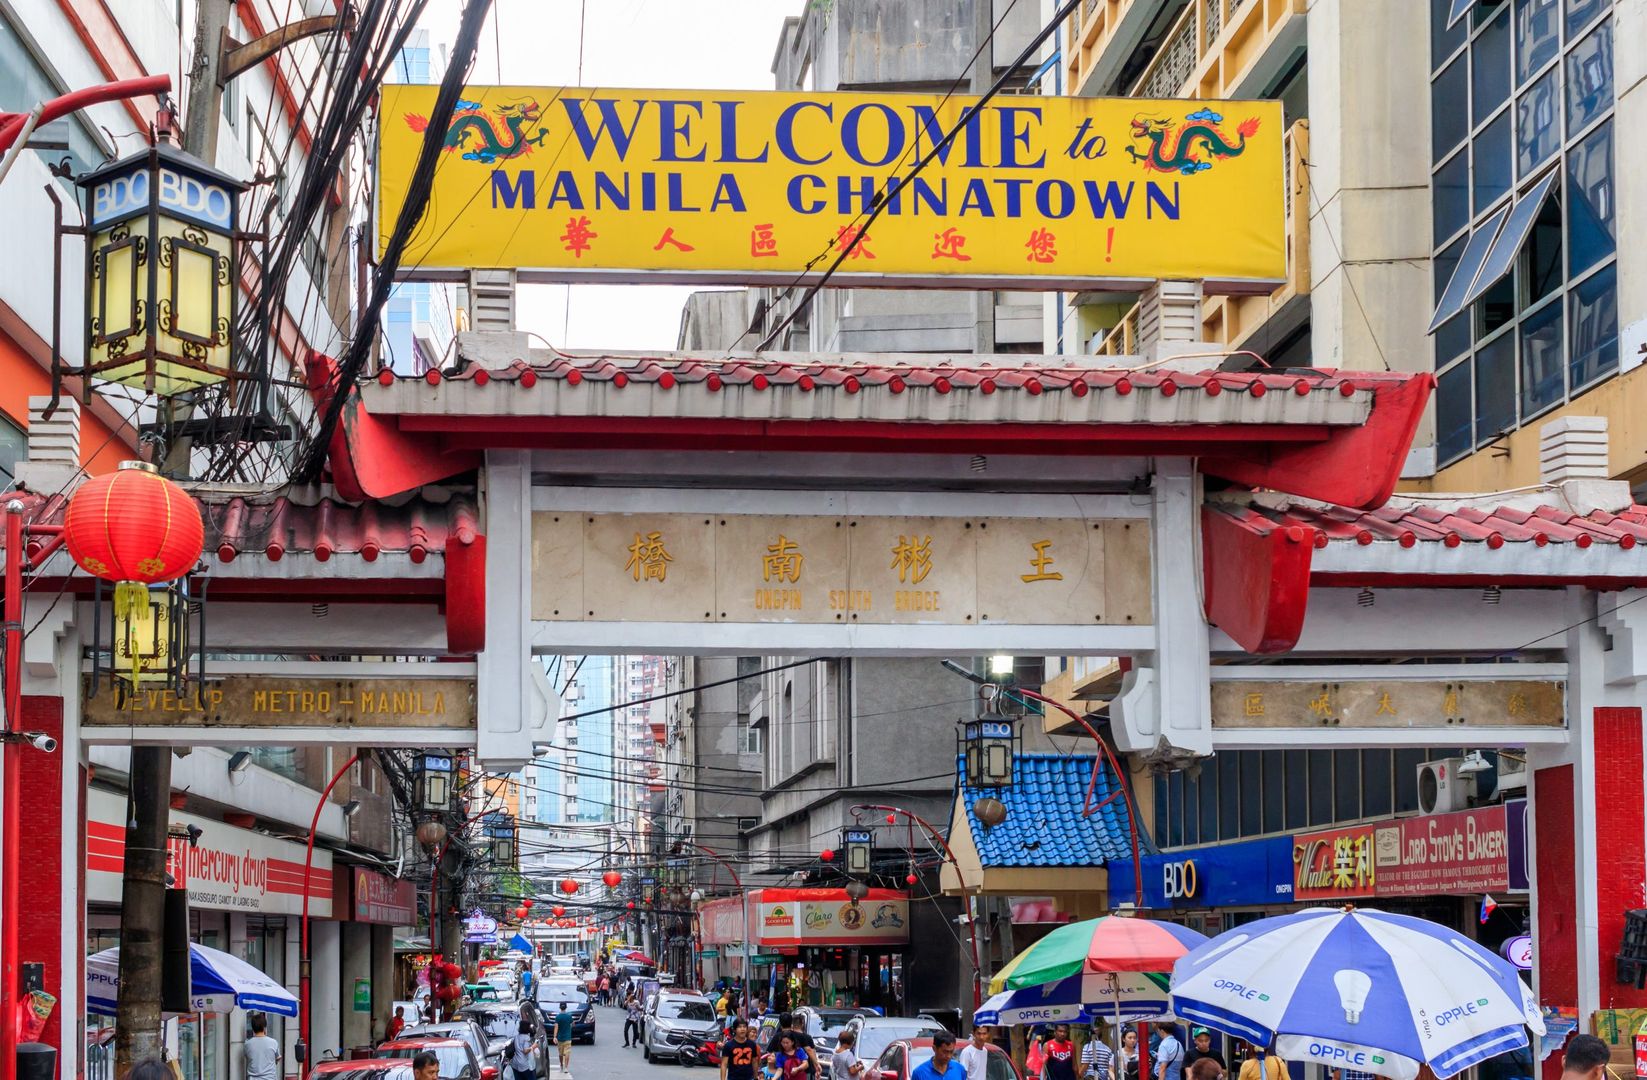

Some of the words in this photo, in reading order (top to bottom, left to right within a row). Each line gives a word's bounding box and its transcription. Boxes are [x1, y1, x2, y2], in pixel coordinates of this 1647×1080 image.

[558, 97, 1047, 169] WELCOME
[1063, 117, 1108, 160] to
[94, 168, 149, 217] BDO
[159, 168, 231, 221] BDO
[491, 169, 747, 212] MANILA
[786, 174, 1181, 220] CHINATOWN
[755, 589, 802, 610] ONGPIN
[828, 590, 873, 611] SOUTH
[896, 590, 941, 611] BRIDGE
[982, 723, 1011, 736] BDO
[425, 756, 451, 770] BDO
[1402, 824, 1427, 865] LORD
[189, 843, 240, 893] mercury
[243, 849, 266, 896] drug
[1164, 860, 1196, 898] BDO
[1276, 884, 1292, 894] ONGPIN
[1099, 987, 1135, 995] OPLE
[1214, 979, 1258, 1000] OPPLE
[1018, 1009, 1050, 1020] OPPLE
[1435, 1002, 1478, 1026] OPPLE
[732, 1047, 753, 1065] 23
[1052, 1050, 1071, 1061] USA
[1309, 1043, 1366, 1065] OPPLE
